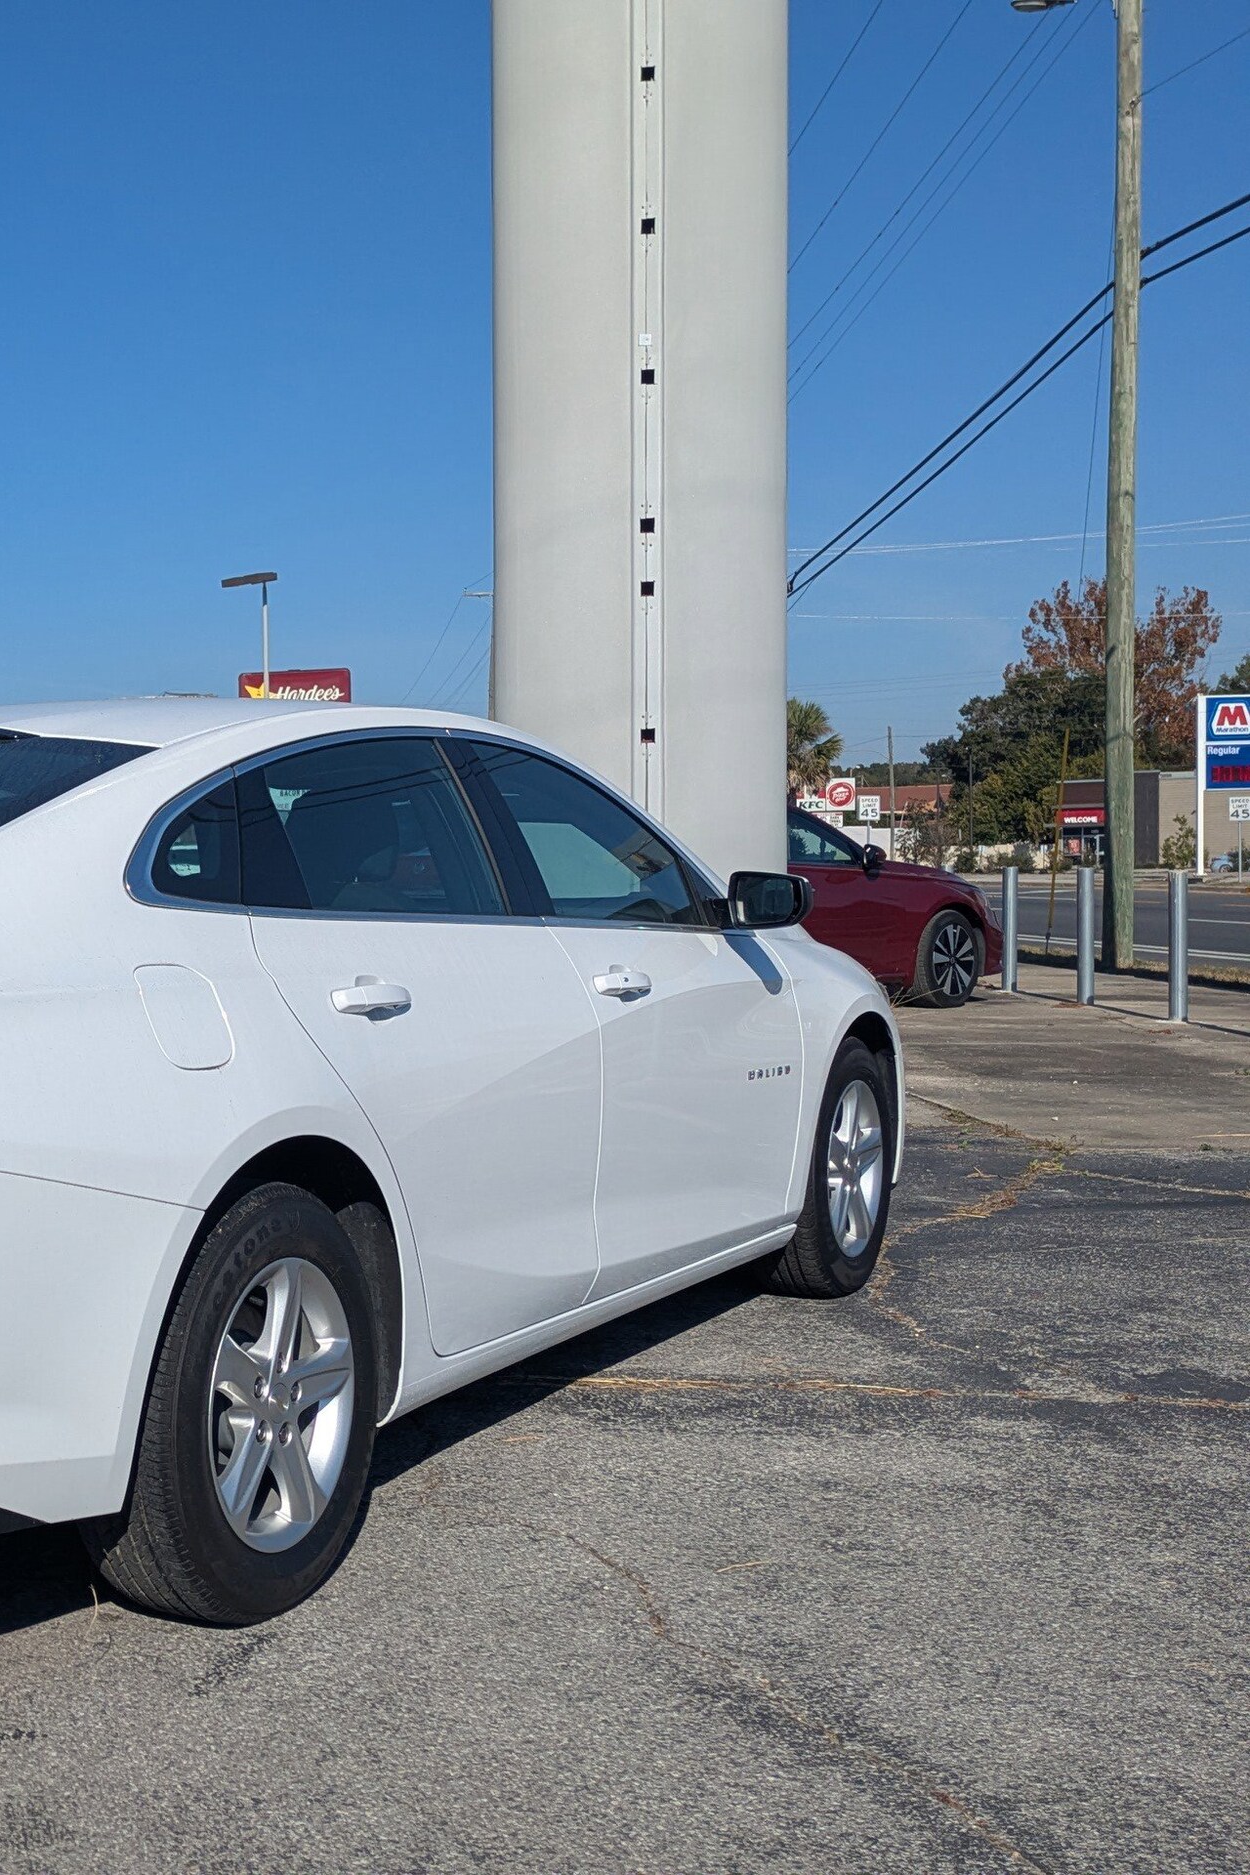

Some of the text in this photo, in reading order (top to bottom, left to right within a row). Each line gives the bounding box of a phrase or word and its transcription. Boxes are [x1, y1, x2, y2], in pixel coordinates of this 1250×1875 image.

[276, 684, 345, 701] Hardee's
[1207, 746, 1241, 757] Regular
[799, 800, 824, 809] KFC
[861, 808, 878, 818] 45
[1230, 809, 1250, 819] 45
[1063, 816, 1098, 824] WELCOME
